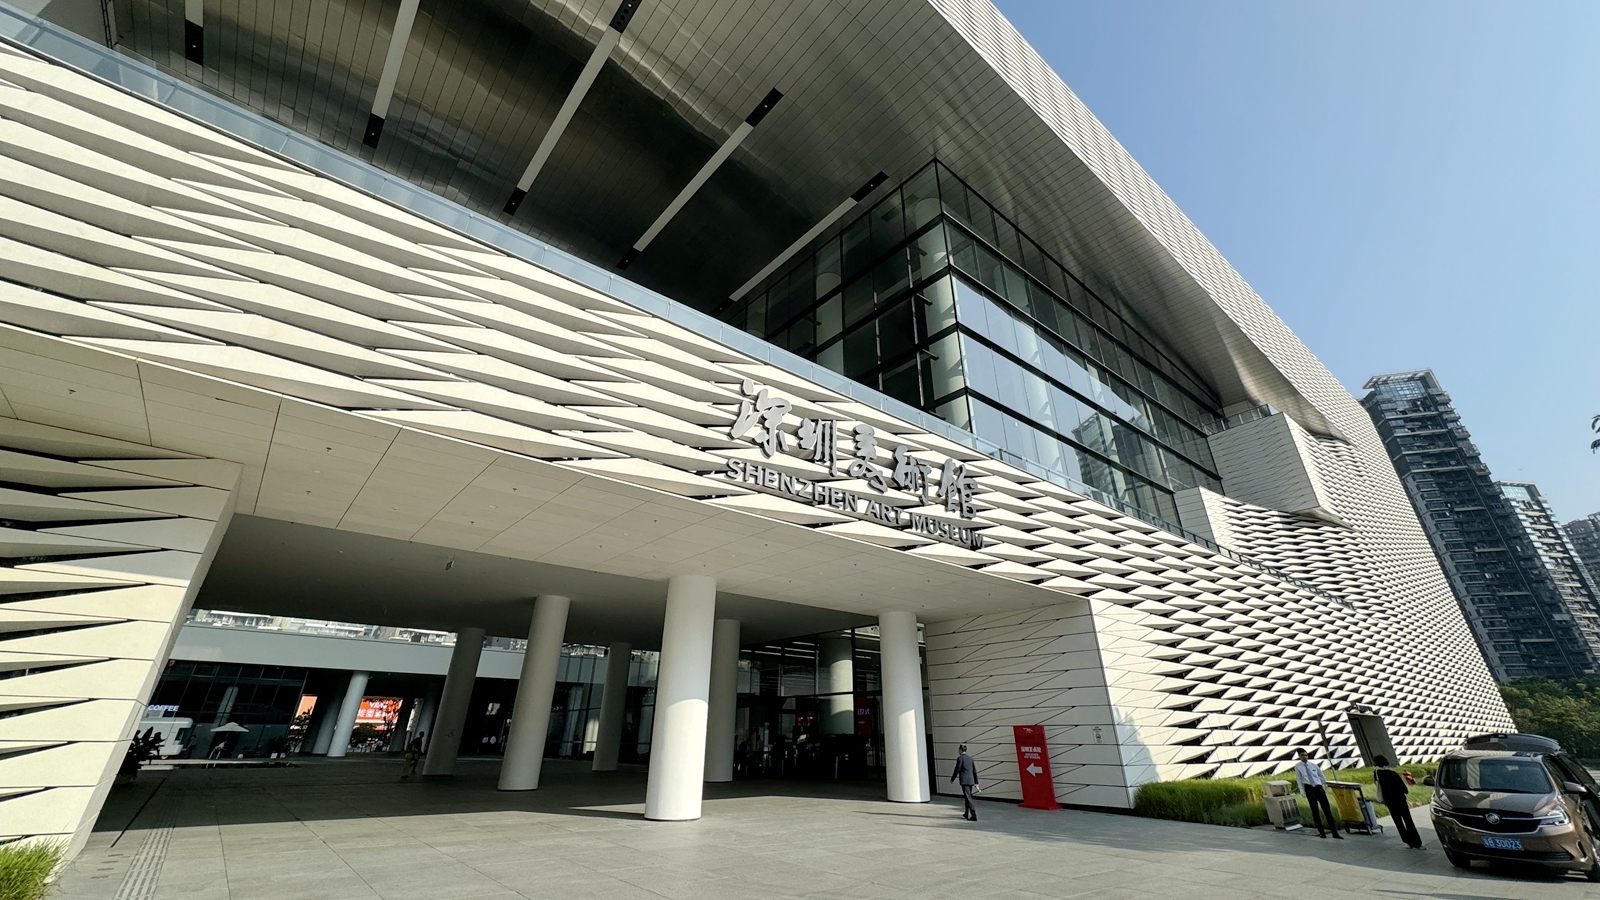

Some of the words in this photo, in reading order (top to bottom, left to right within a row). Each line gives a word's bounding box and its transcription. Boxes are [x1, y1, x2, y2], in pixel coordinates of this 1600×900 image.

[725, 458, 858, 512] SHENZHEN
[866, 500, 904, 525] ART
[910, 512, 984, 549] MUSEUM
